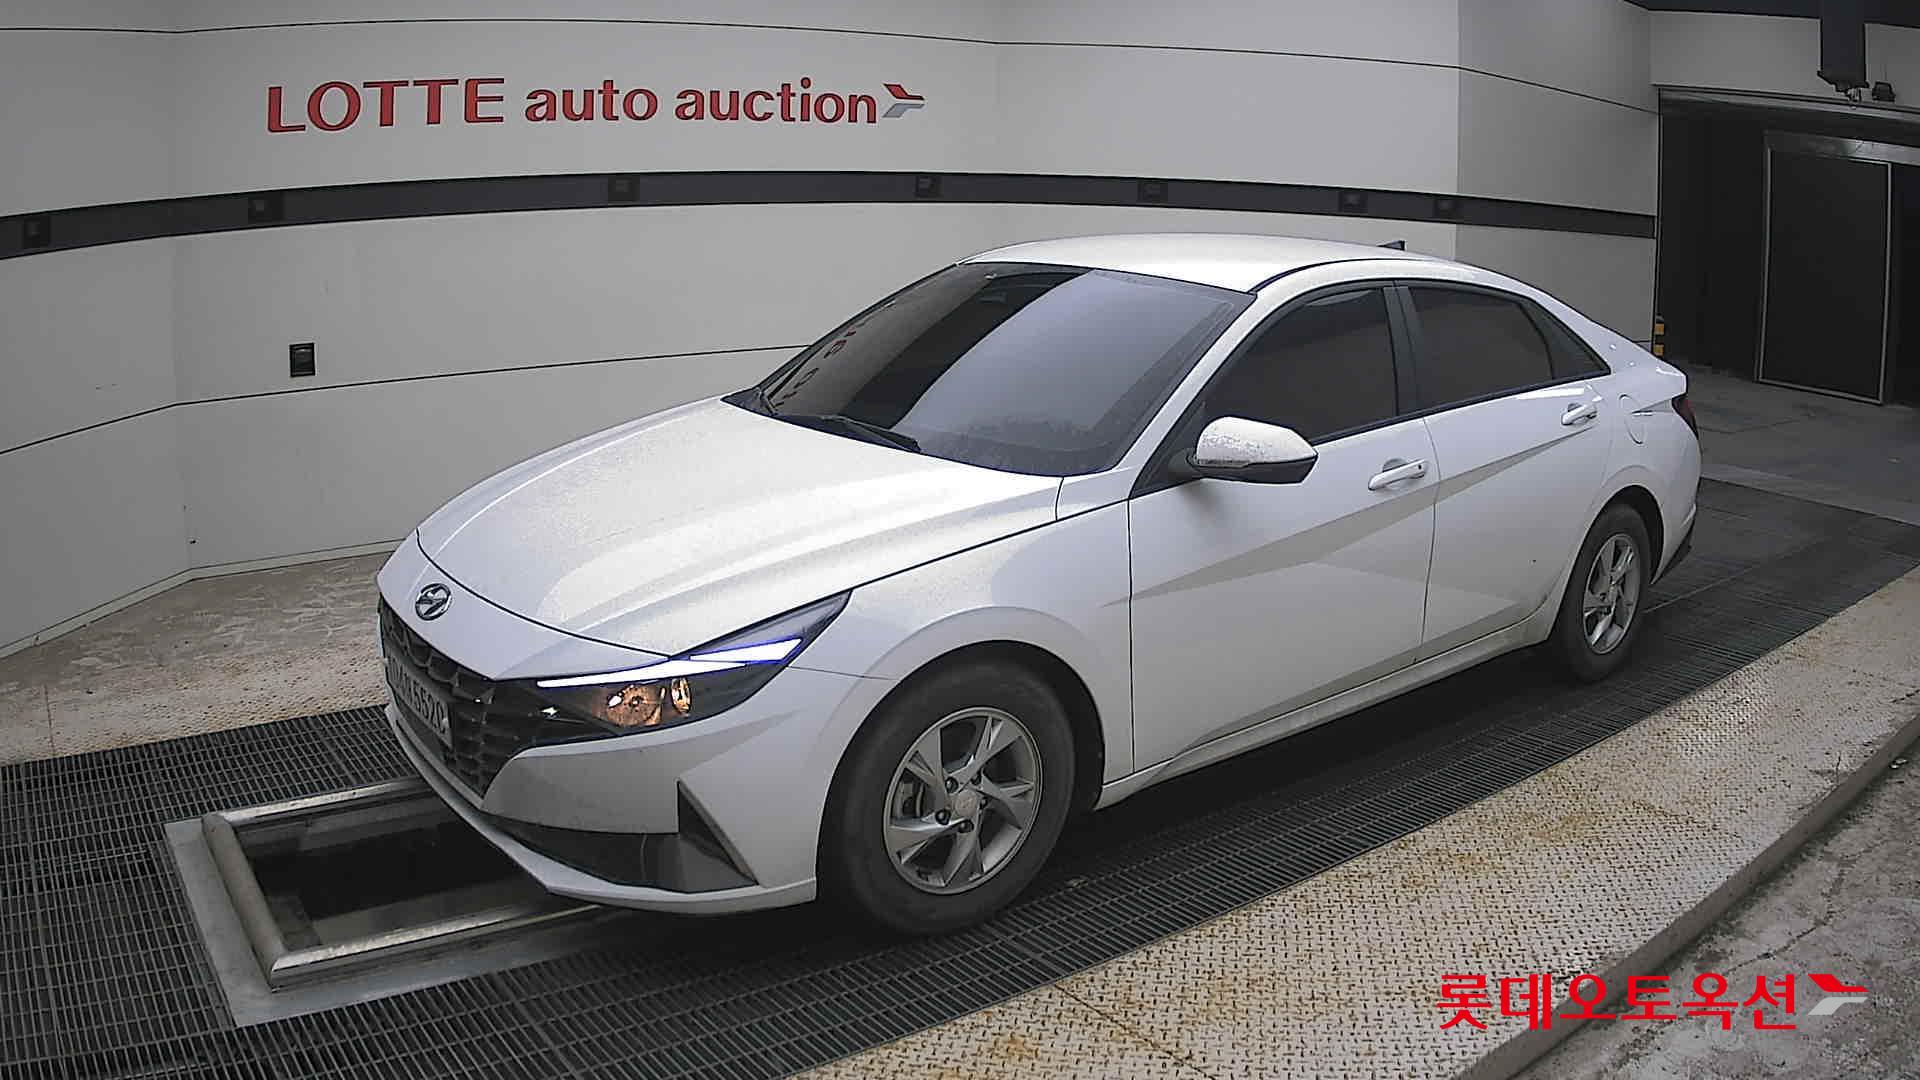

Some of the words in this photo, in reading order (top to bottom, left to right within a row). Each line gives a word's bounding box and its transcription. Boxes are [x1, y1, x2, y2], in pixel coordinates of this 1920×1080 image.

[267, 78, 505, 133] LOTTE
[525, 79, 658, 122] auto
[675, 77, 878, 124] auction
